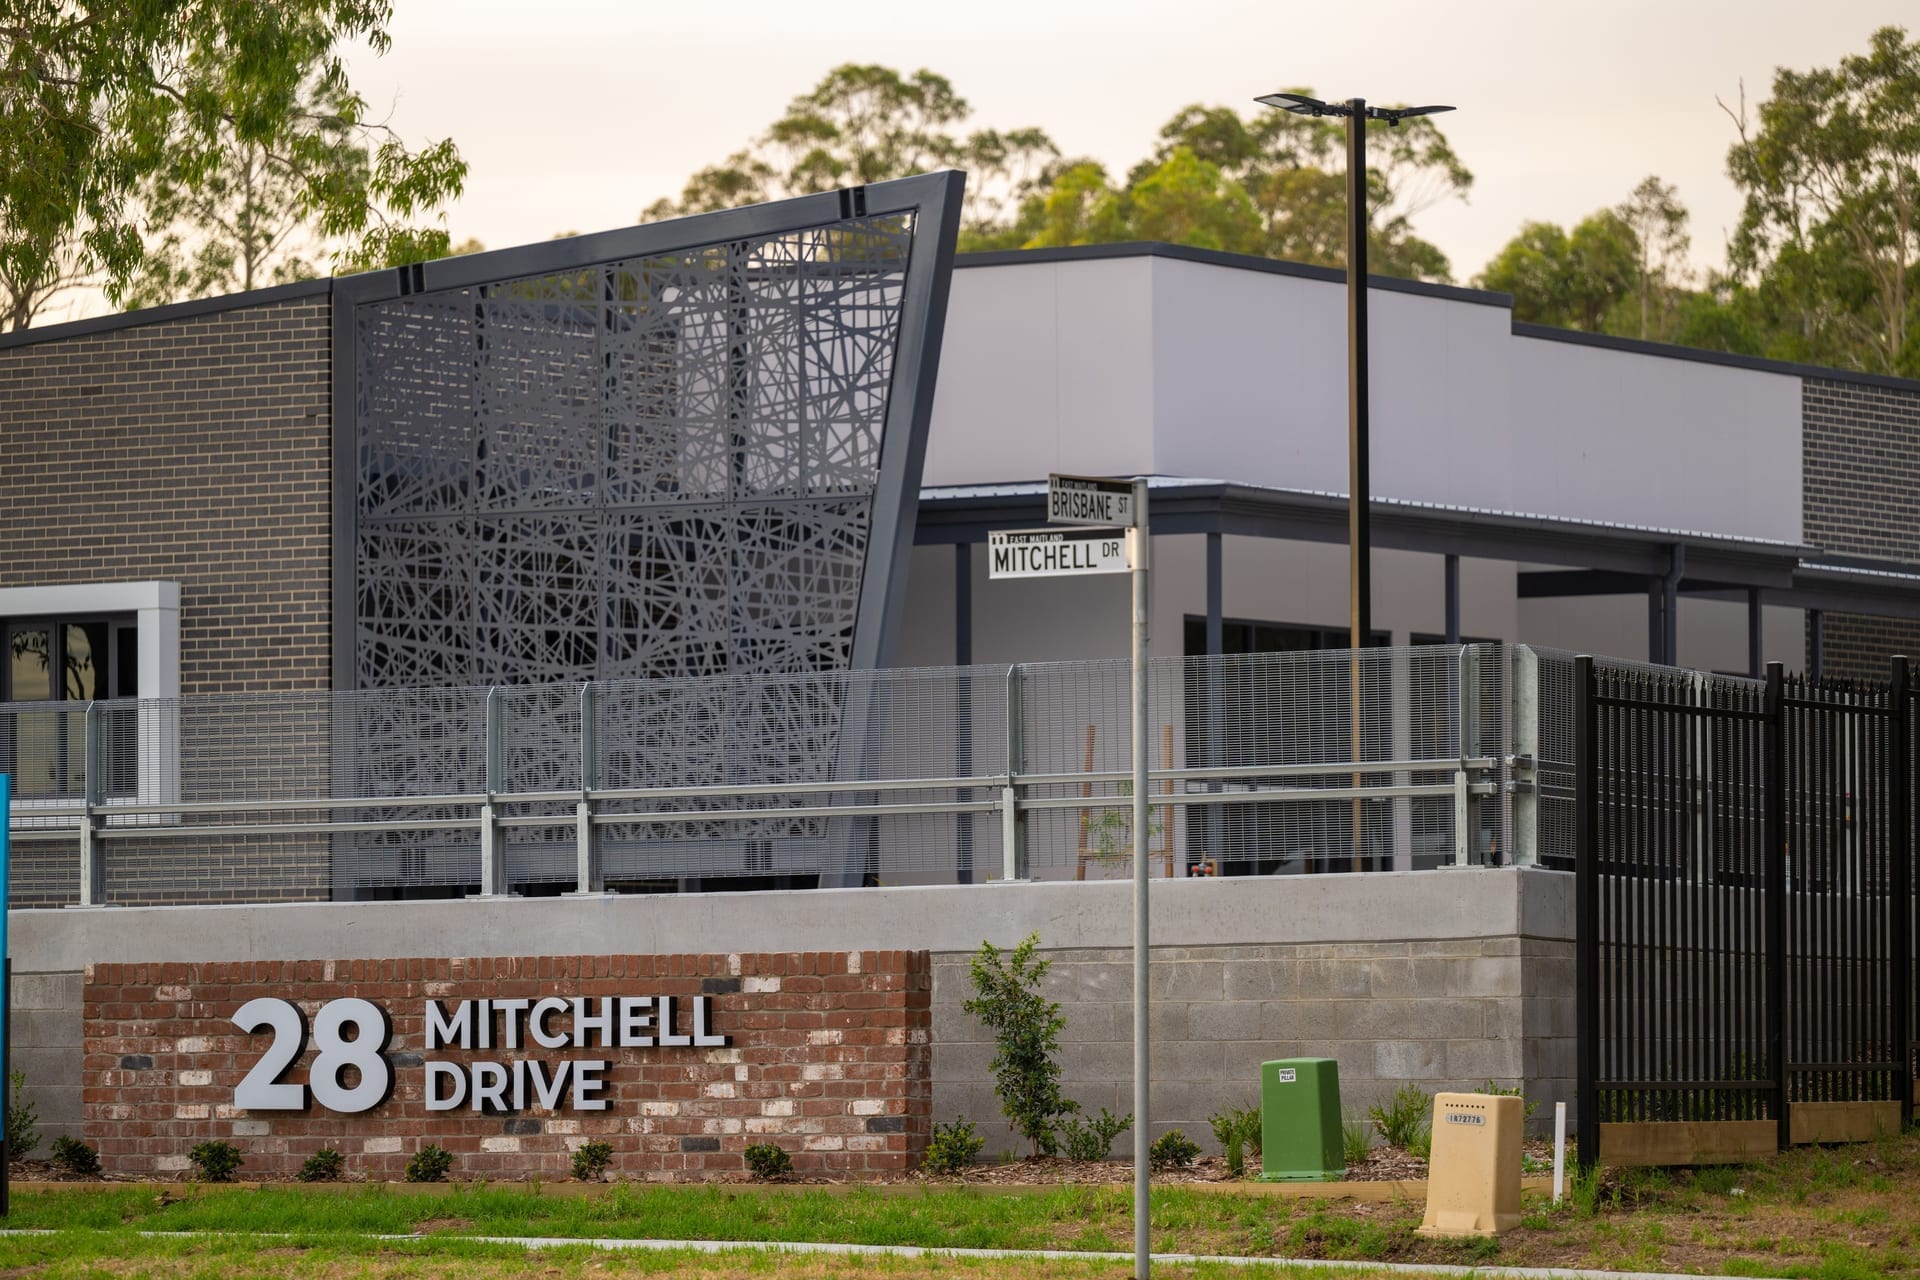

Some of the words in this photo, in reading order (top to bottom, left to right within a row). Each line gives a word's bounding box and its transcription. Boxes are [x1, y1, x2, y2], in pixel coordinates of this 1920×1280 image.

[1052, 491, 1112, 520] BRISBANE
[1118, 496, 1128, 513] ST
[994, 543, 1097, 573] MITCHELL
[1102, 542, 1119, 557] DR
[1009, 535, 1027, 544] EAST
[1029, 533, 1063, 544] MAITLAND
[425, 996, 728, 1050] MITCHELL
[231, 997, 392, 1113] 28
[425, 1060, 610, 1112] DRIVE
